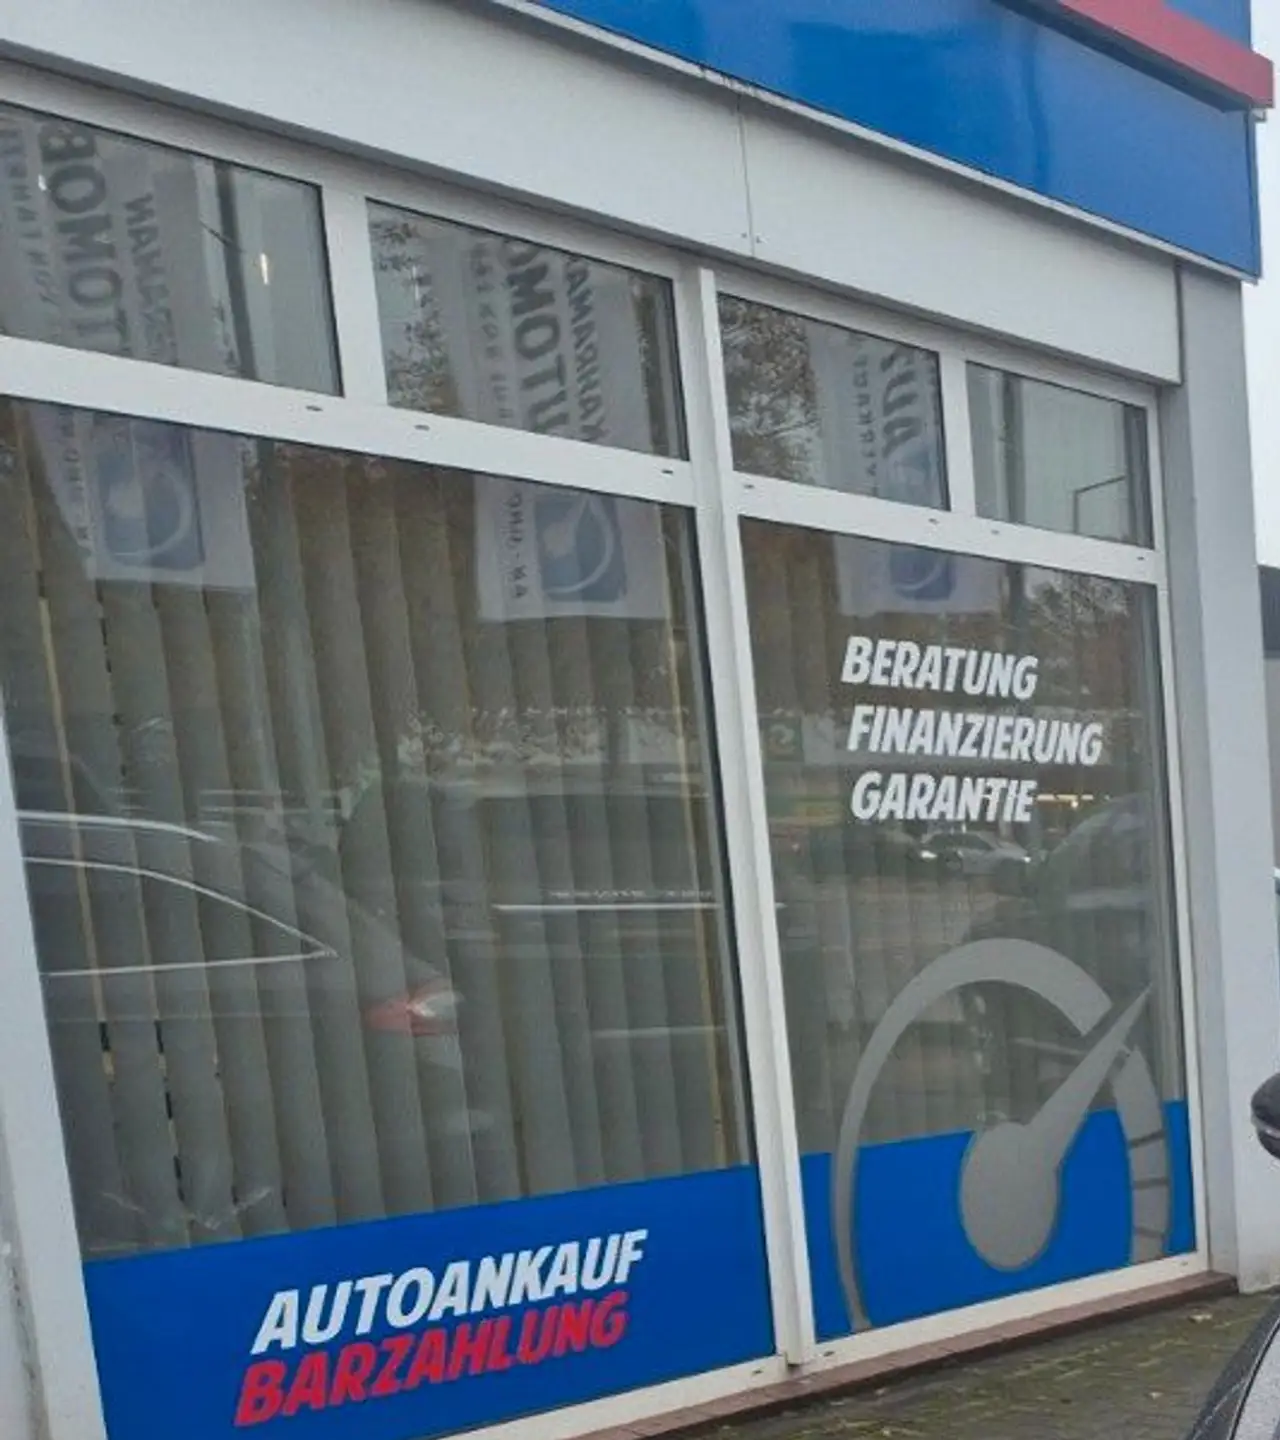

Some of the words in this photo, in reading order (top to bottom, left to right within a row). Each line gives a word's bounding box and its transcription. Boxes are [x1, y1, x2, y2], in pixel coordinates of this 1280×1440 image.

[841, 636, 1039, 700] BERATUNG
[847, 704, 1104, 766] FINANZIERUNG
[851, 771, 1038, 822] GARANTIE
[251, 1229, 648, 1355] AUTOANKAUF
[234, 1291, 630, 1427] BARZAHLUNG
